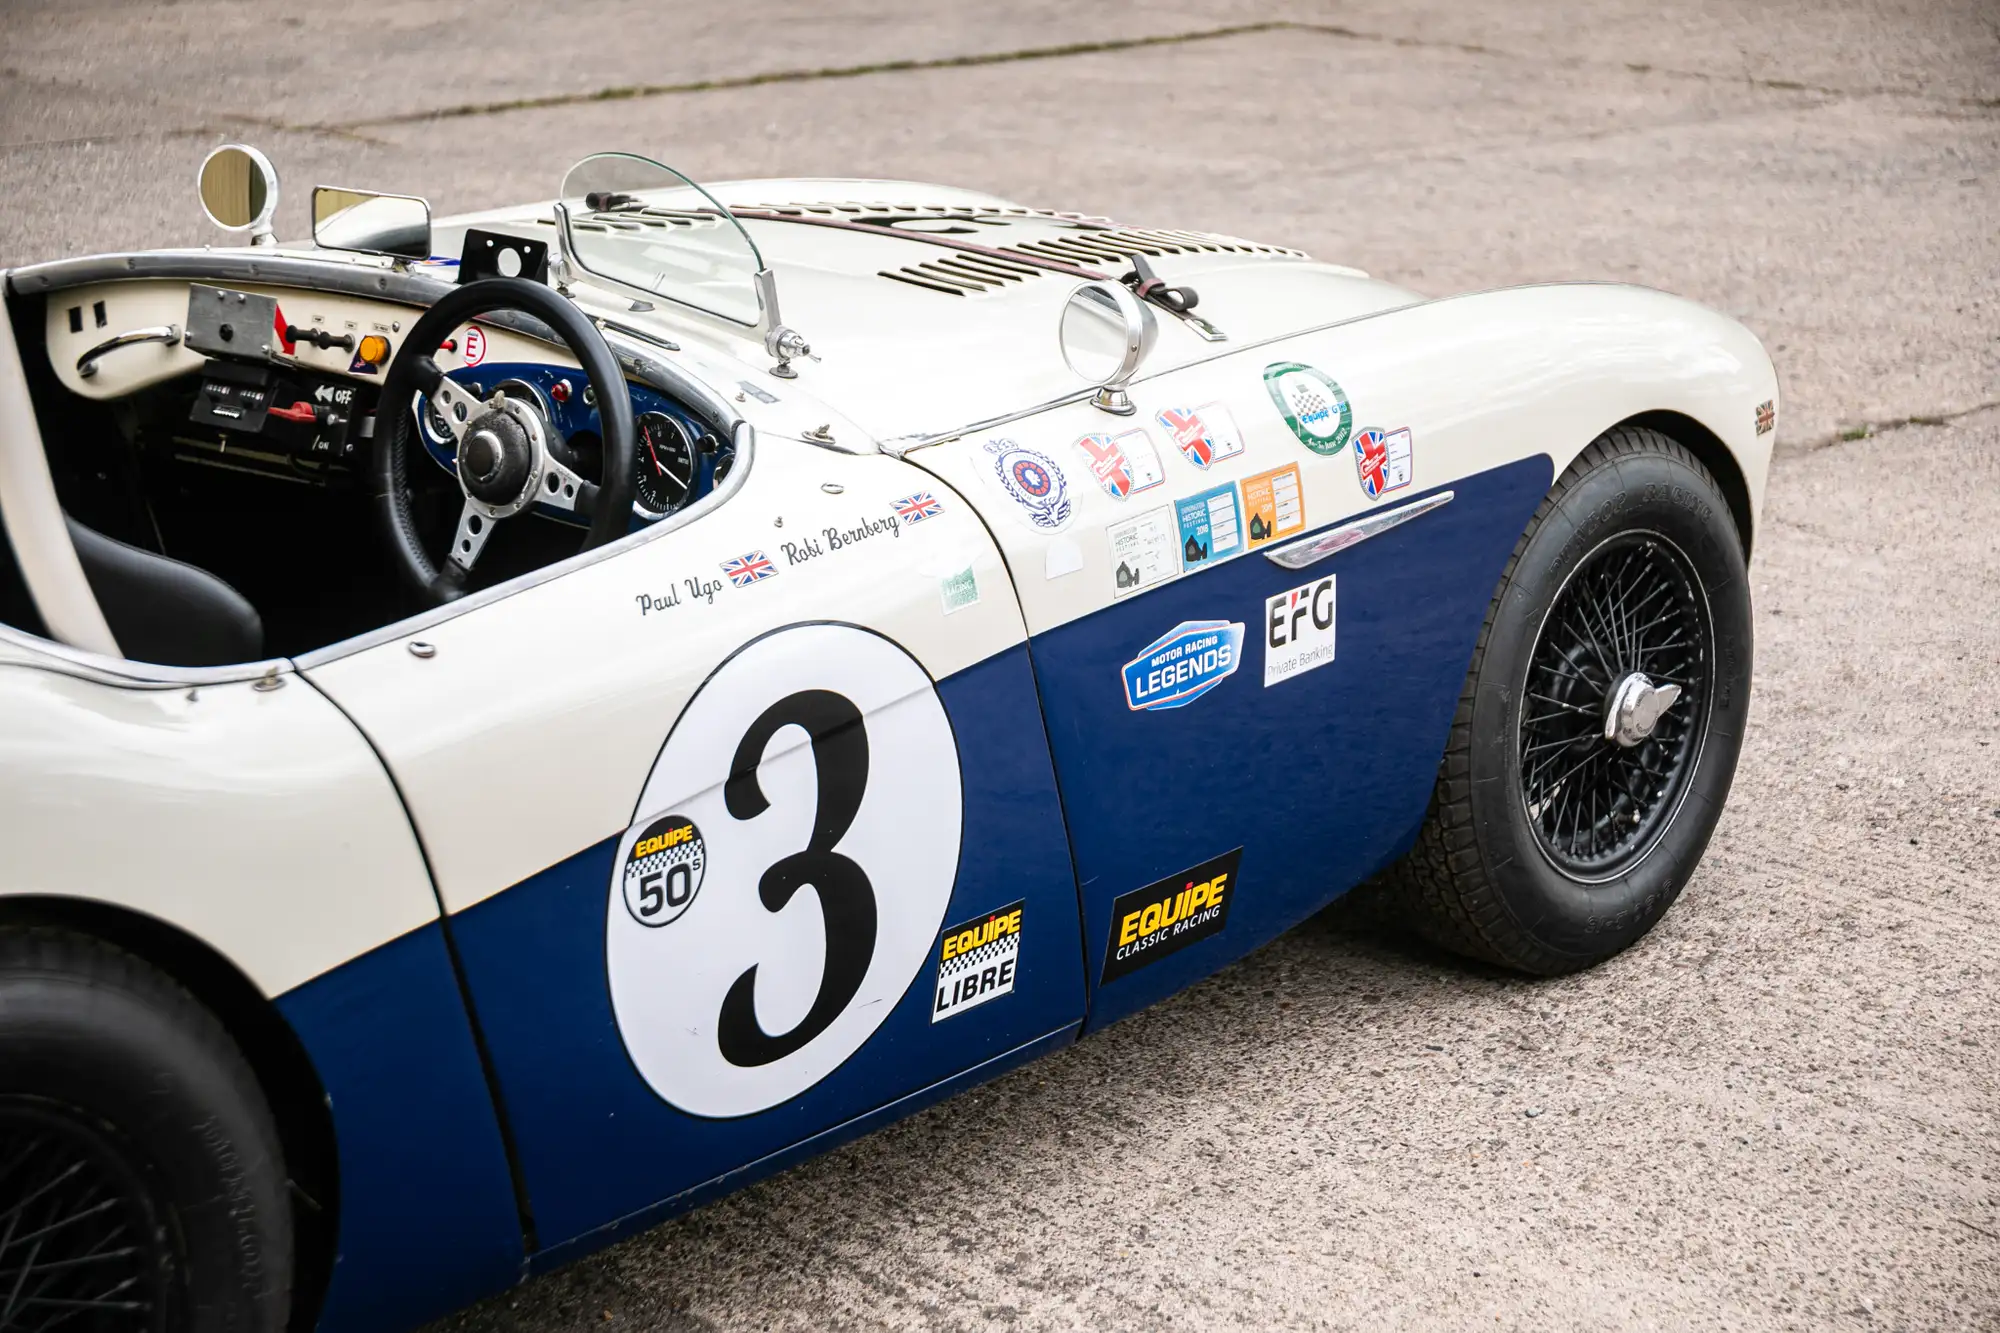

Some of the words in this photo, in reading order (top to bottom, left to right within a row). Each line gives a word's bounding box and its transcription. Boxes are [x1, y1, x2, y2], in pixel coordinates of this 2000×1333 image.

[466, 336, 478, 358] E
[335, 390, 353, 405] OFF
[1182, 509, 1207, 522] HISTORIC
[1183, 517, 1208, 528] FESTIVAL
[1196, 523, 1209, 536] 2018
[1549, 490, 1628, 574] DUNLOP
[1642, 482, 1714, 524] RACING
[780, 537, 824, 566] Robi
[822, 514, 900, 551] Bernberg
[635, 583, 682, 616] Paul
[684, 577, 723, 604] Ugo
[1269, 580, 1333, 648] EFG
[1151, 646, 1182, 667] MOTOR
[1185, 635, 1218, 655] RACING
[1267, 658, 1298, 677] Private
[1299, 644, 1333, 666] Banking
[1136, 643, 1232, 699] LEGENDS
[717, 688, 878, 1068] 3
[1116, 928, 1170, 961] CLASSIC
[1172, 904, 1221, 936] RACING
[935, 957, 1015, 1013] LIBRE
